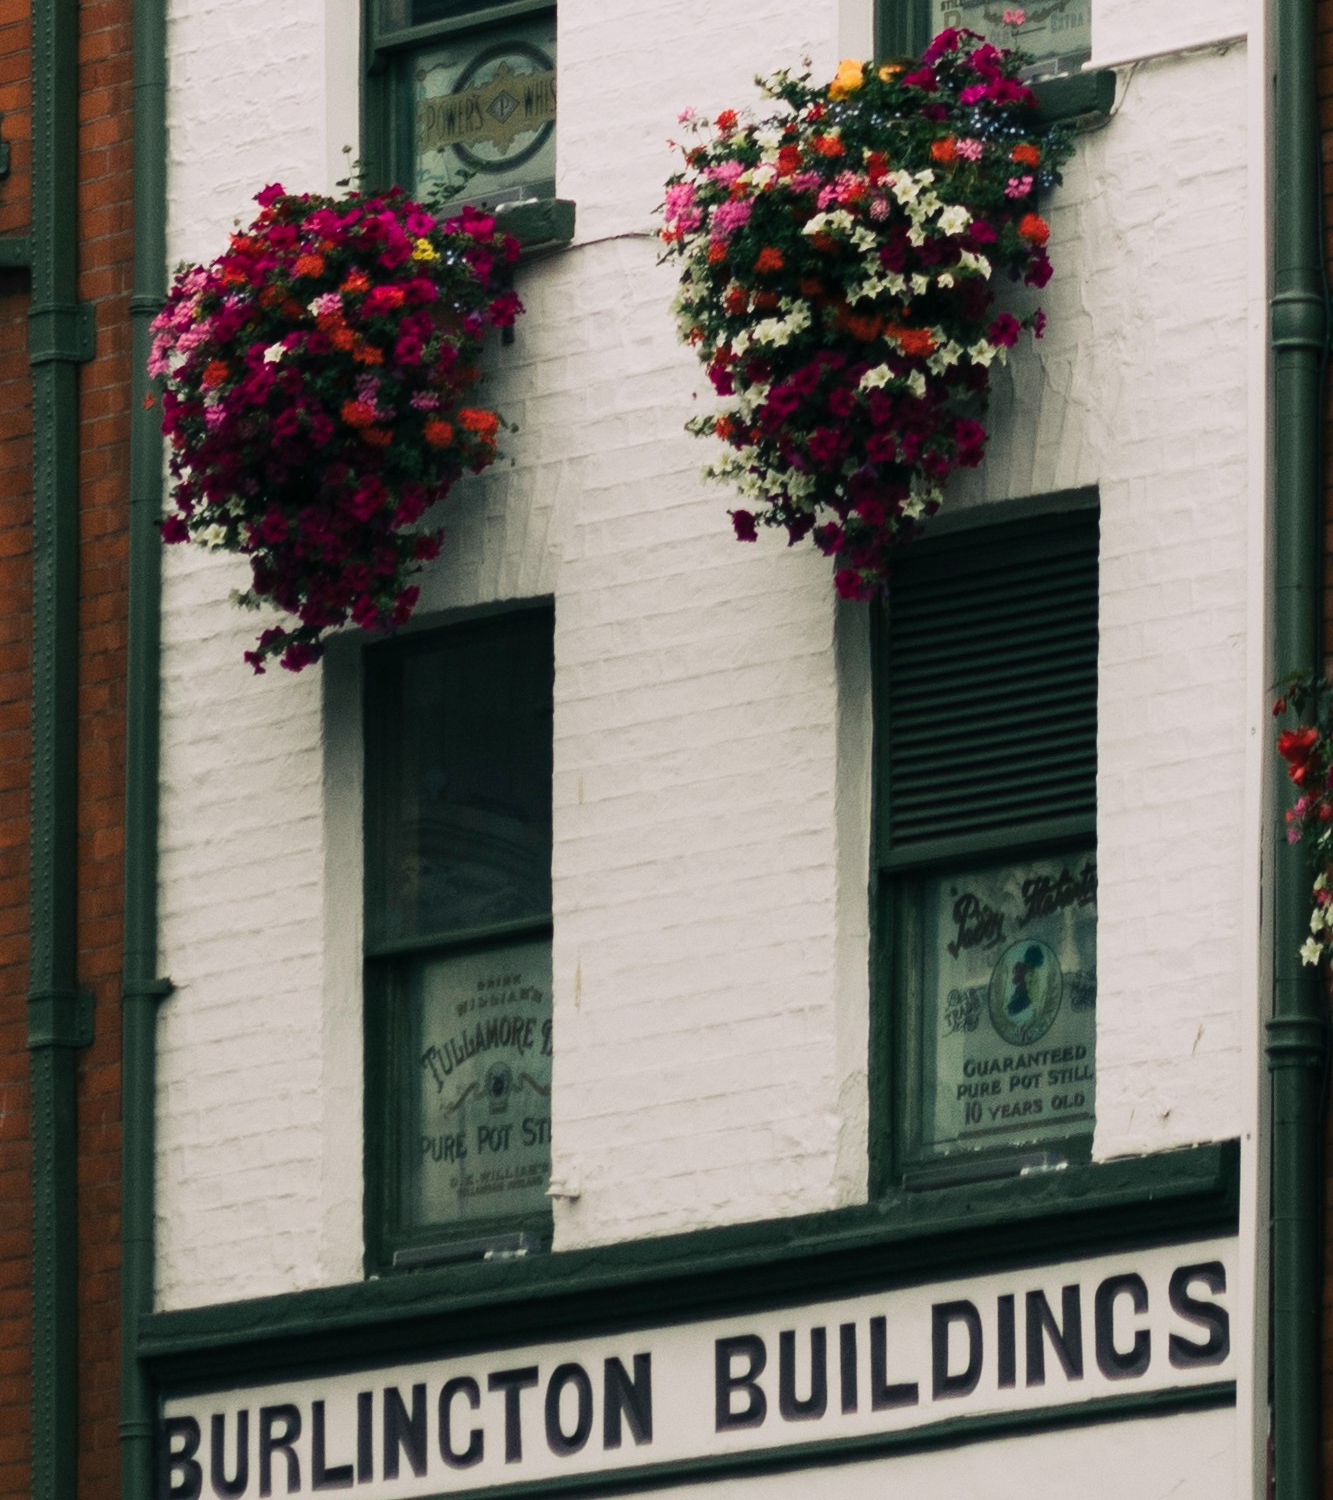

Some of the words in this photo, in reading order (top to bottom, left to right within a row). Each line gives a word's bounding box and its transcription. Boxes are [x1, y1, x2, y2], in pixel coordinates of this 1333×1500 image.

[419, 1015, 538, 1093] TULLAMORE
[962, 1046, 1087, 1079] GUARANTEED
[956, 1080, 1001, 1101] PURE
[1008, 1073, 1042, 1093] POT
[1046, 1065, 1094, 1086] STILL
[964, 1101, 982, 1125] 10
[986, 1099, 1043, 1121] YEARS
[1050, 1091, 1085, 1111] OLD
[420, 1131, 468, 1164] PURE
[476, 1123, 513, 1155] POT
